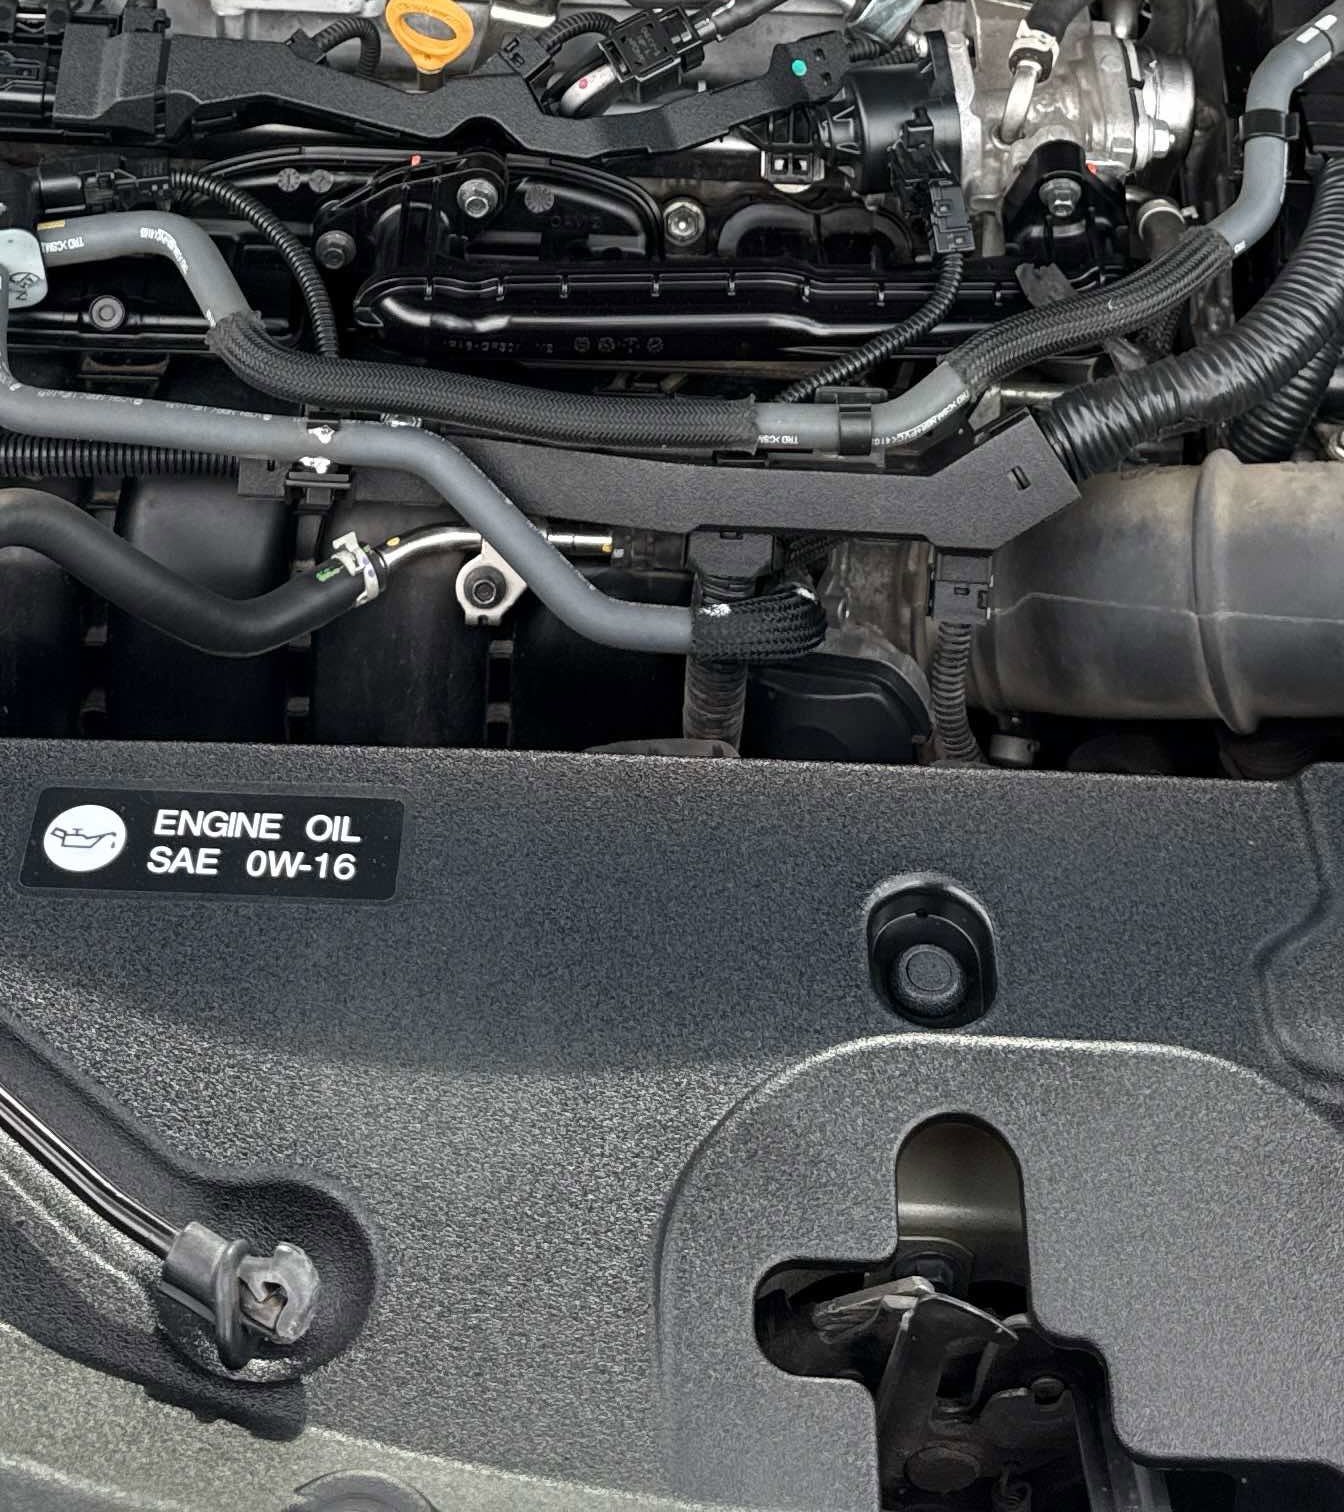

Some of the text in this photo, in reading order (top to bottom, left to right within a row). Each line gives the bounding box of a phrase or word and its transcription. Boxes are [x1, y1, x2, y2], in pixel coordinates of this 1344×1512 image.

[781, 435, 799, 445] TRD
[153, 808, 362, 844] ENGINE OIL
[146, 846, 358, 881] SAE 0W-16
